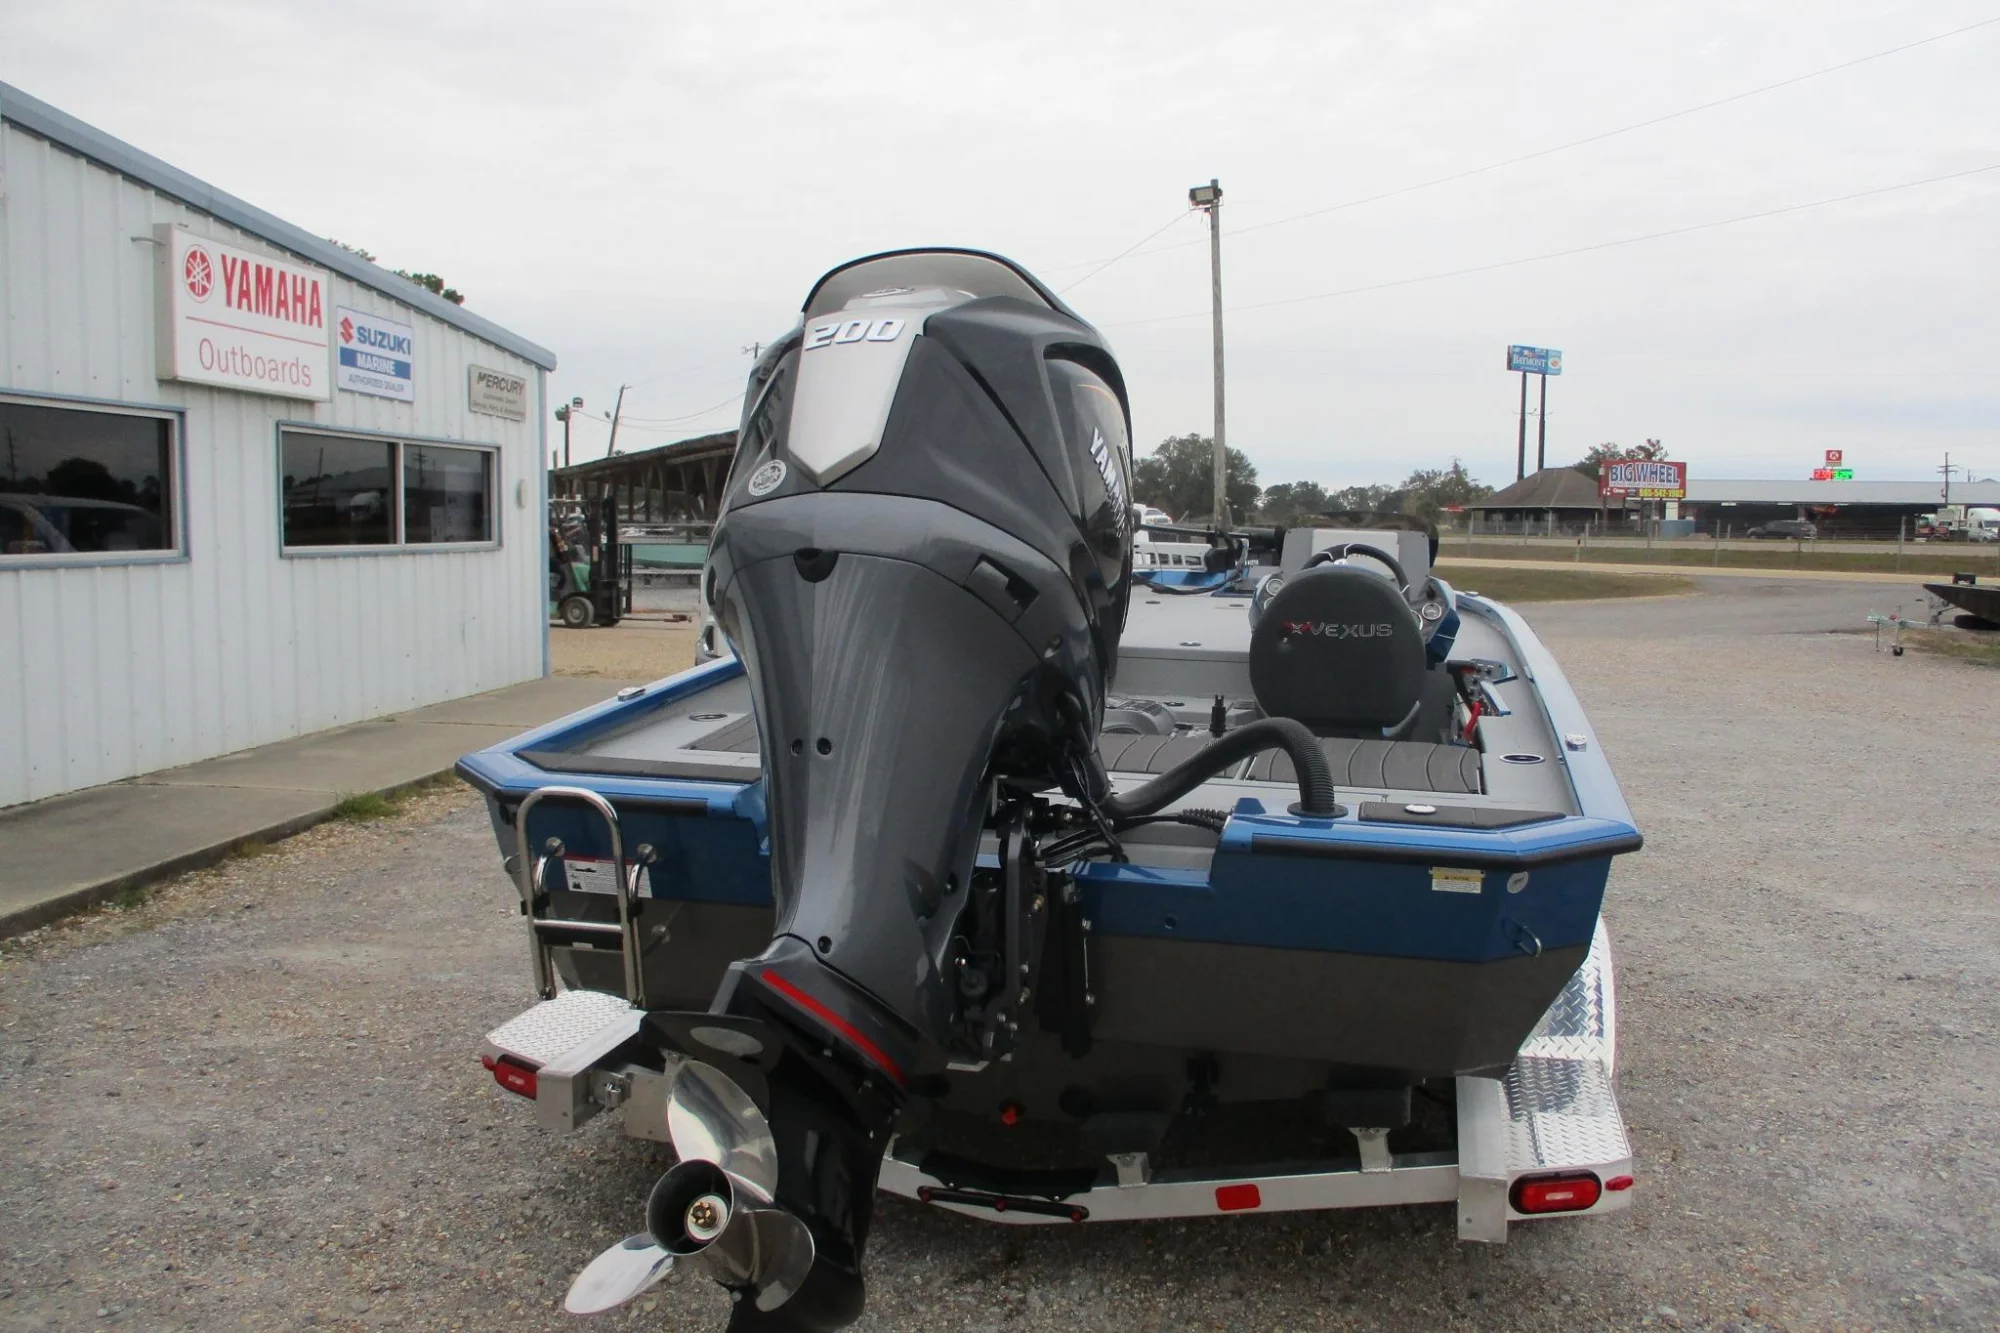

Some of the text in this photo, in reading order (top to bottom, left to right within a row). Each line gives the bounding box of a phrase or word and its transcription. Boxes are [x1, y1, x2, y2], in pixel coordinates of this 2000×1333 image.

[221, 253, 322, 329] YAMAHA
[356, 326, 411, 356] SUZUKI
[804, 318, 906, 352] 200
[199, 338, 312, 388] Outboards
[356, 352, 397, 375] MARINE
[476, 371, 524, 396] MERCURY
[1609, 462, 1680, 484] BIG WHEEL
[1307, 621, 1393, 640] VEXUS
